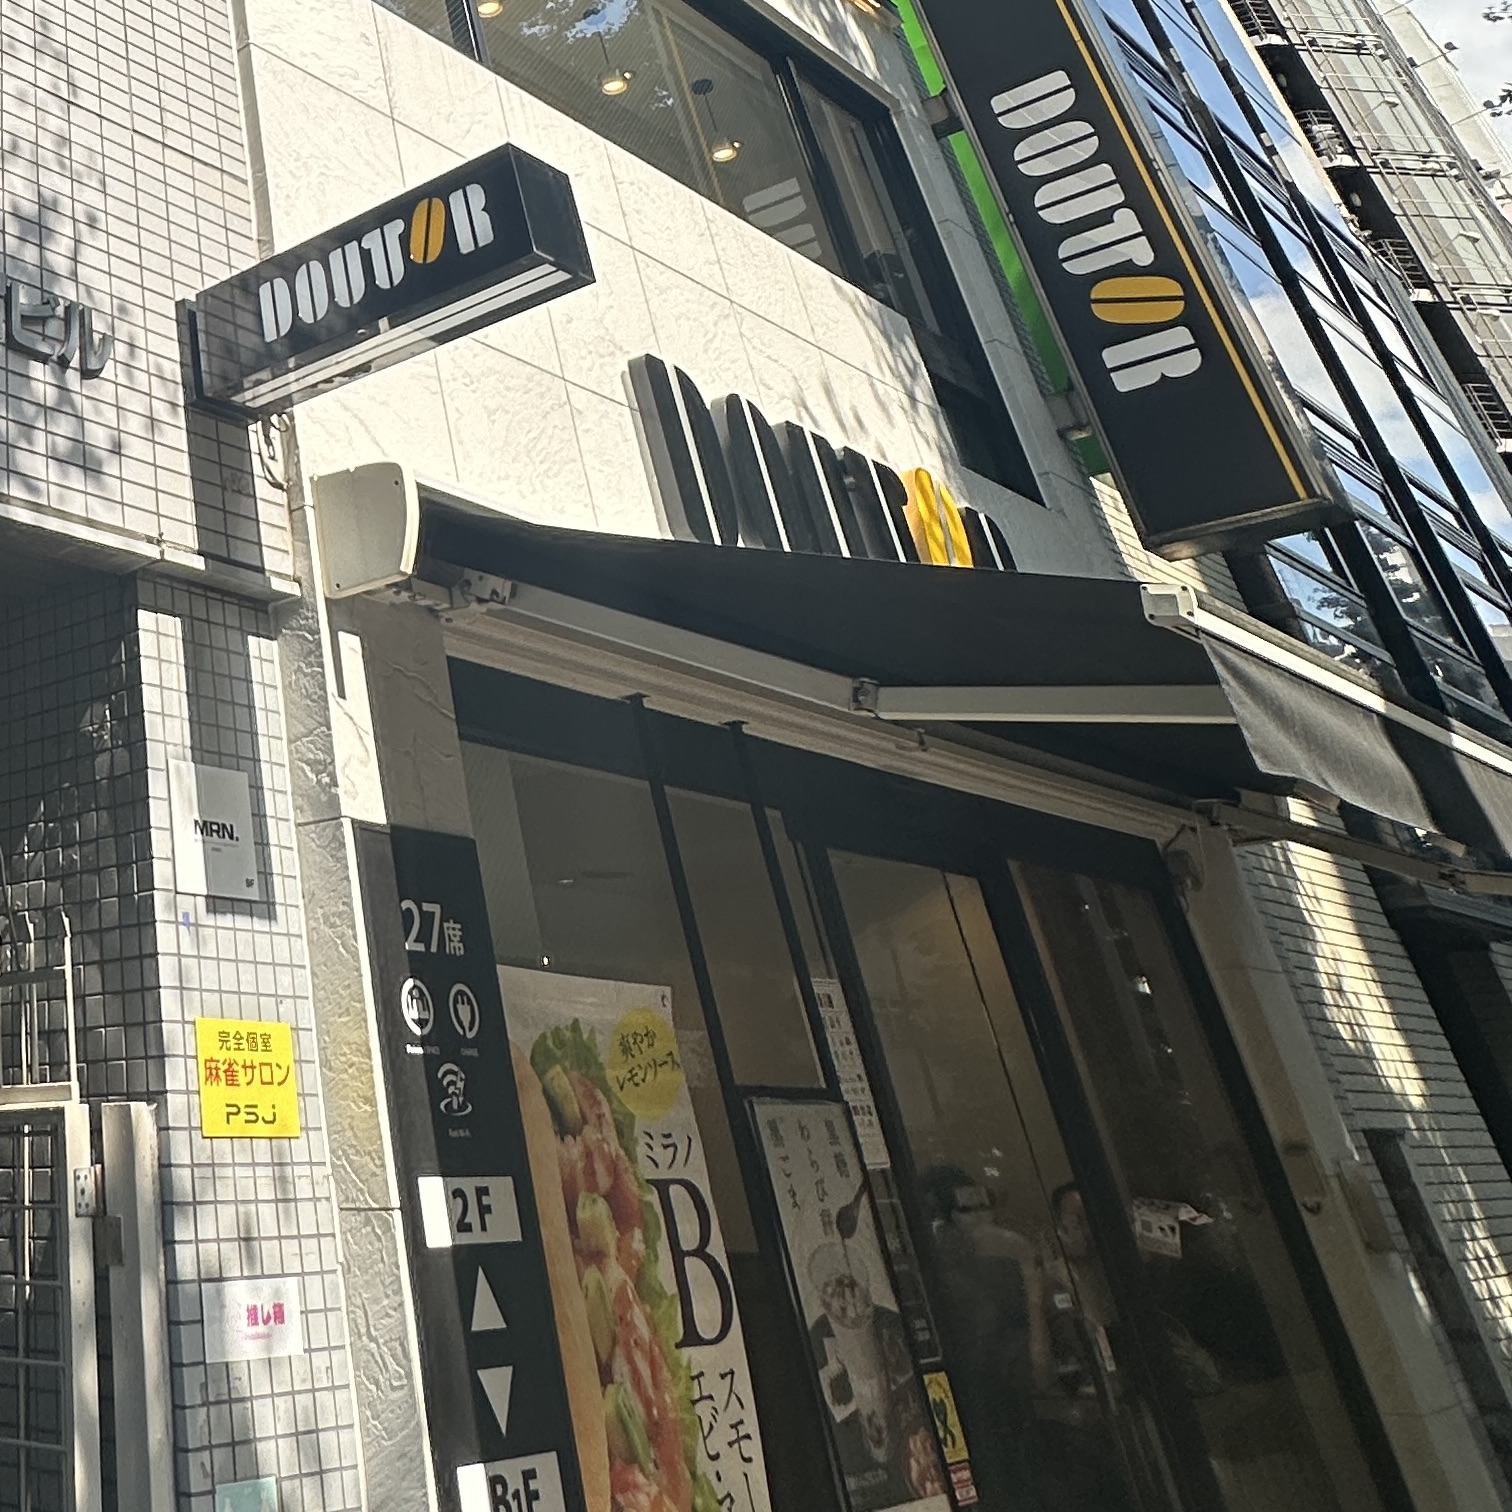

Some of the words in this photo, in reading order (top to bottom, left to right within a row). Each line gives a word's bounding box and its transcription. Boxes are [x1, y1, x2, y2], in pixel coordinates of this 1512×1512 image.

[990, 69, 1203, 394] DOUTOR
[258, 182, 495, 344] DOUTOR
[400, 899, 465, 956] 27席
[218, 1030, 273, 1053] 完全個室
[204, 1056, 290, 1087] 麻雀サロン
[642, 1130, 693, 1170] ミラノ
[451, 1186, 493, 1234] 2F
[645, 1177, 735, 1349] B
[488, 1467, 541, 1512] B1F
